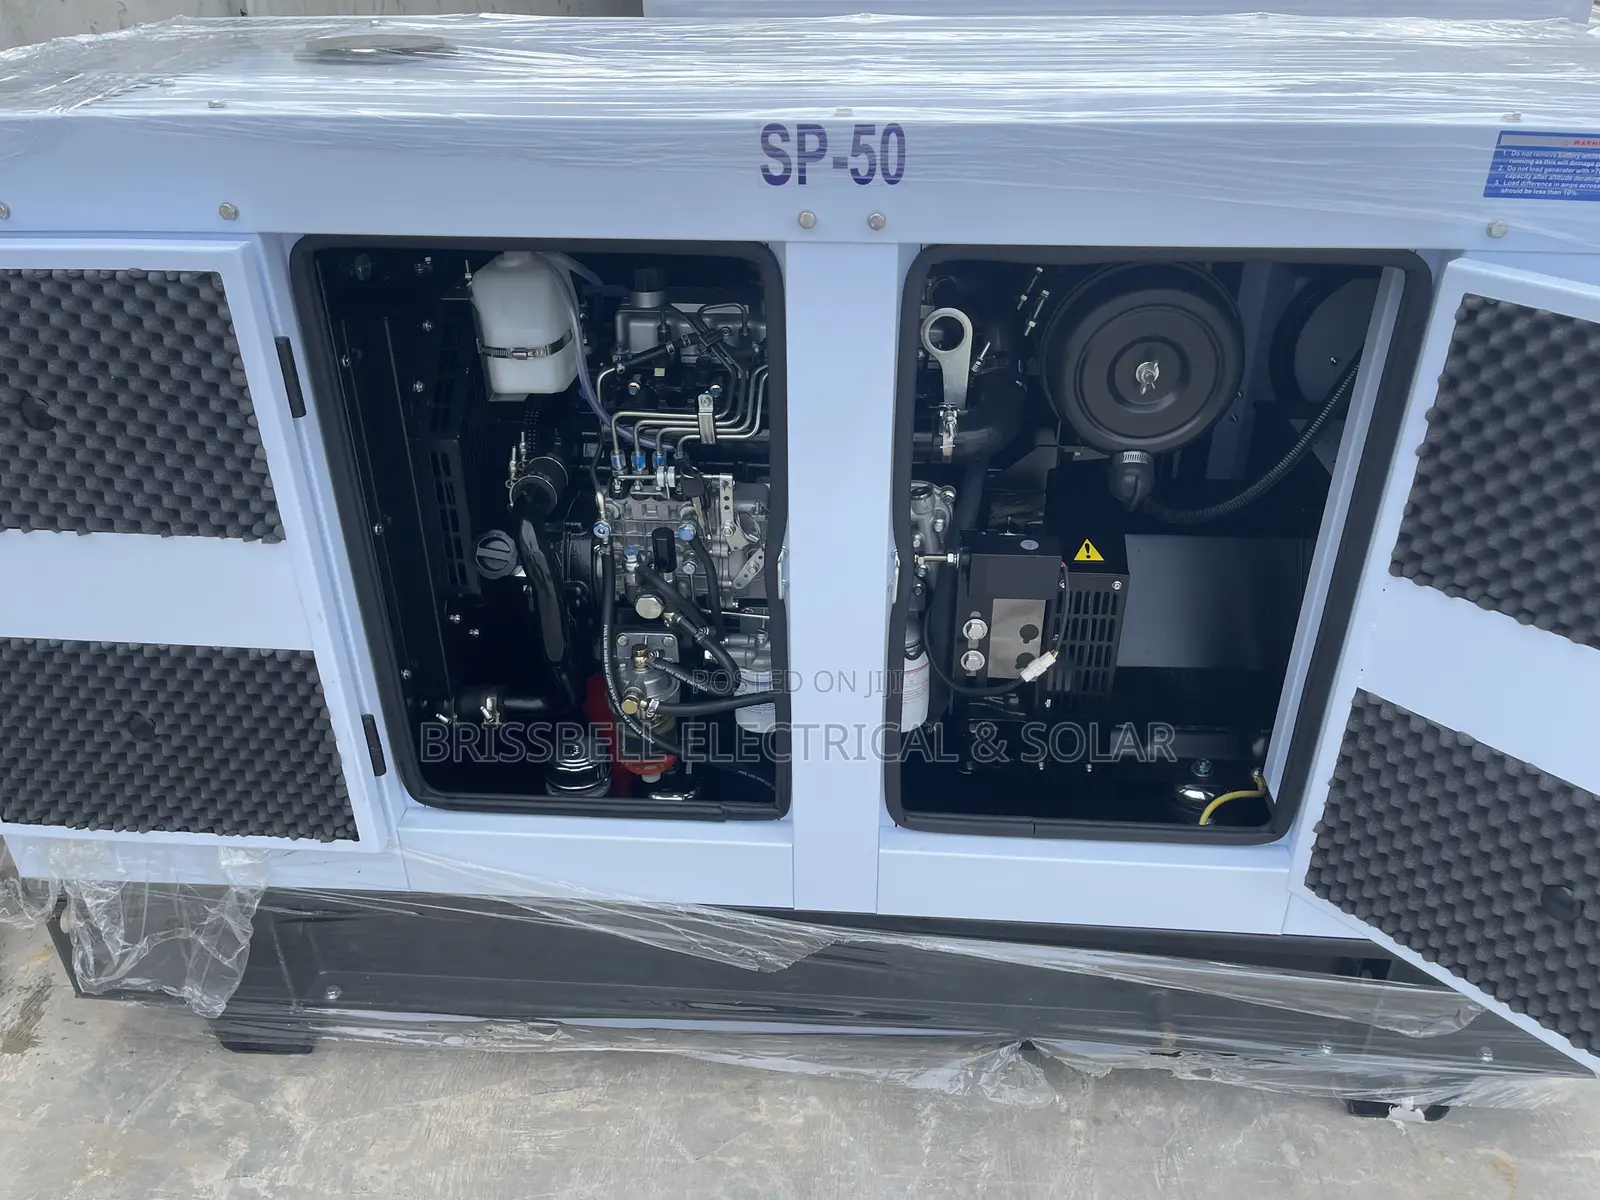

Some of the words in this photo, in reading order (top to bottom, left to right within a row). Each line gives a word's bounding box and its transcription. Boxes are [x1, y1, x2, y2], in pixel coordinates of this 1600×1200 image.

[760, 122, 906, 186] SP-50
[1558, 152, 1581, 160] battery
[1569, 160, 1595, 168] damage
[1573, 175, 1600, 183] derating
